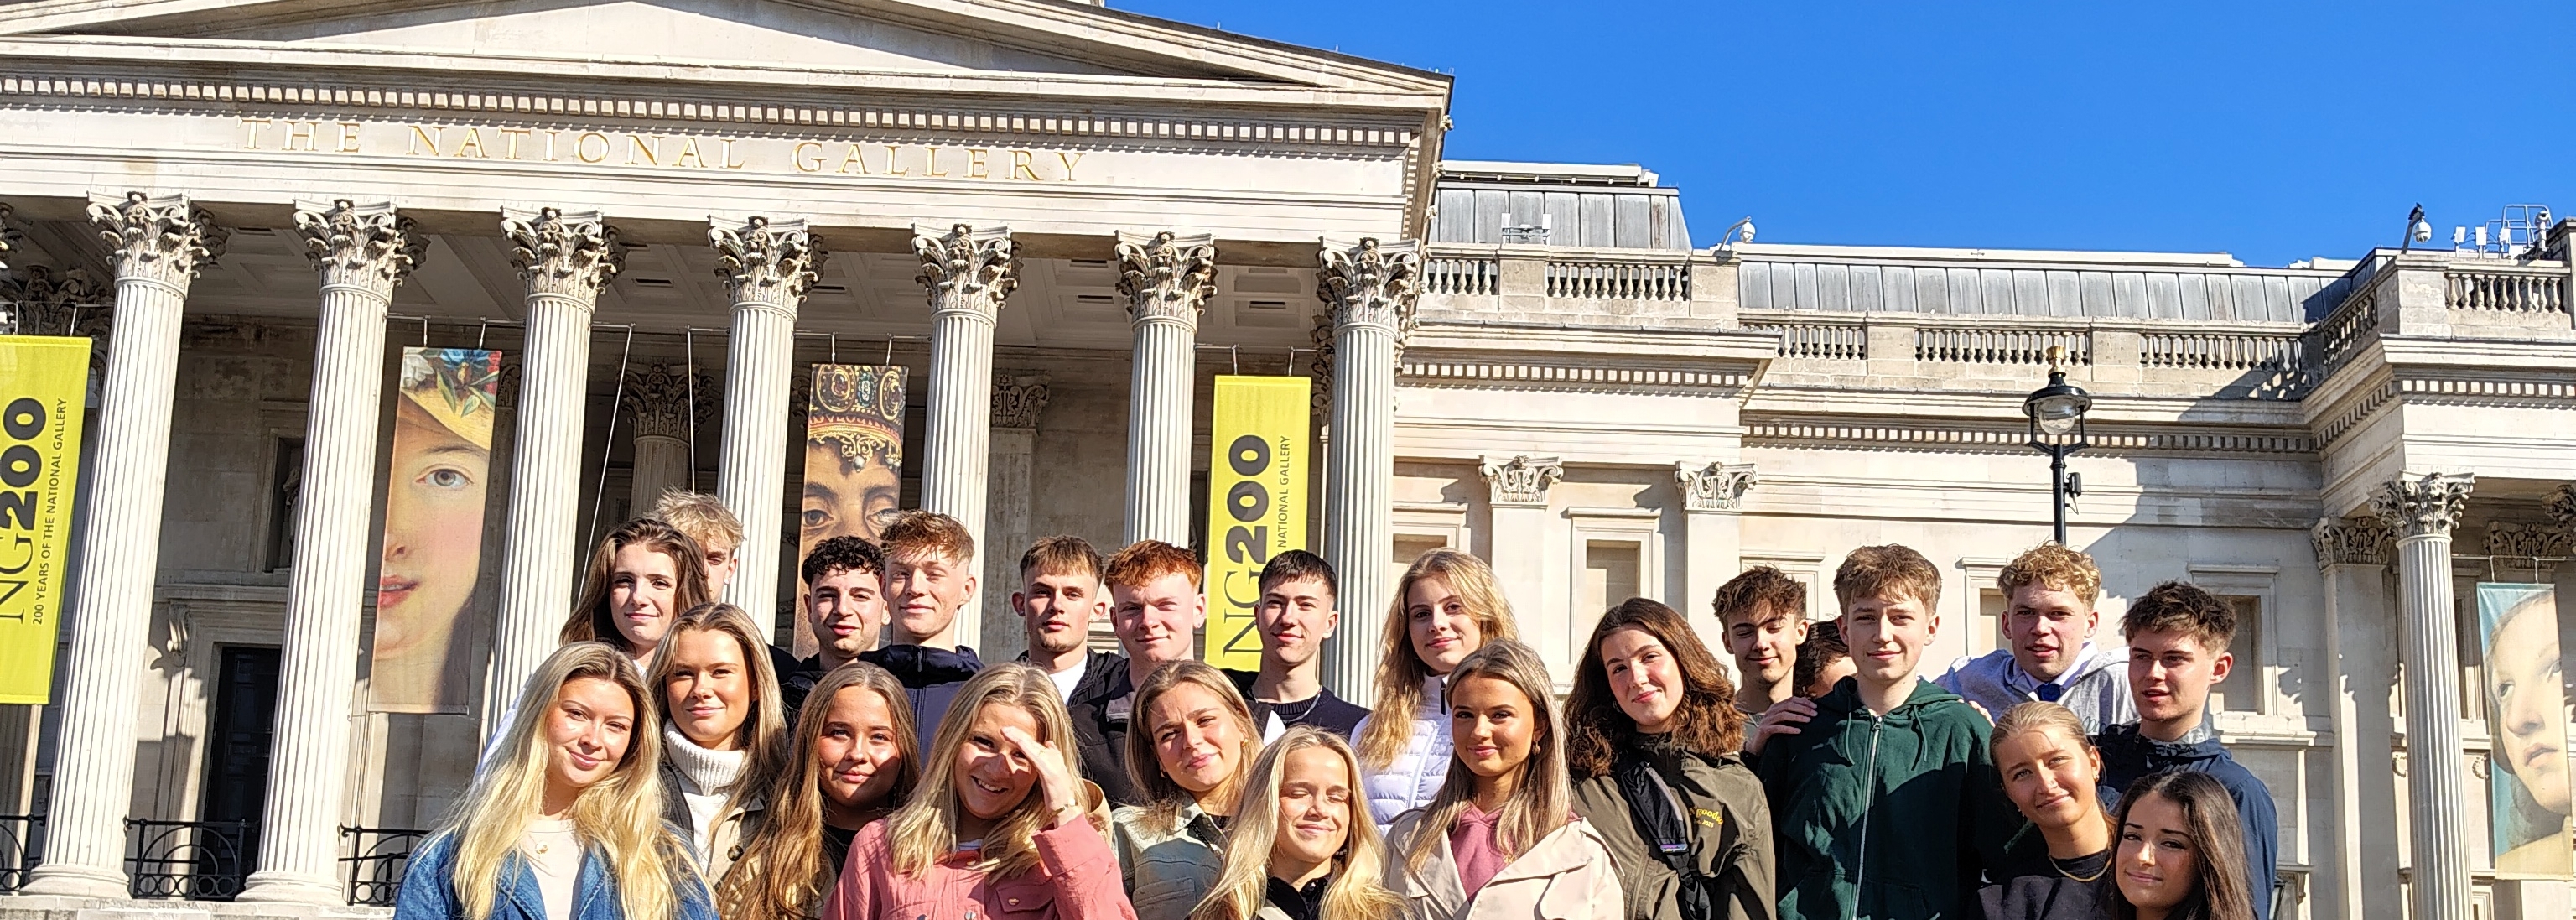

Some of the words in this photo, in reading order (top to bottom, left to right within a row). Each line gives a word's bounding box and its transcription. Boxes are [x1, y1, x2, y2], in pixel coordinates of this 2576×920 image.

[236, 118, 361, 153] THE
[406, 125, 745, 169] NATIONAL
[790, 142, 1087, 182] GALLERY
[53, 398, 67, 450] GALLERY
[46, 453, 62, 513] NATIONAL
[1279, 435, 1291, 486] GALLERY
[43, 517, 55, 539] THE
[1277, 489, 1289, 548] NATIONAL
[41, 543, 51, 559] OF
[36, 563, 49, 600] YEARS
[33, 605, 44, 625] 200
